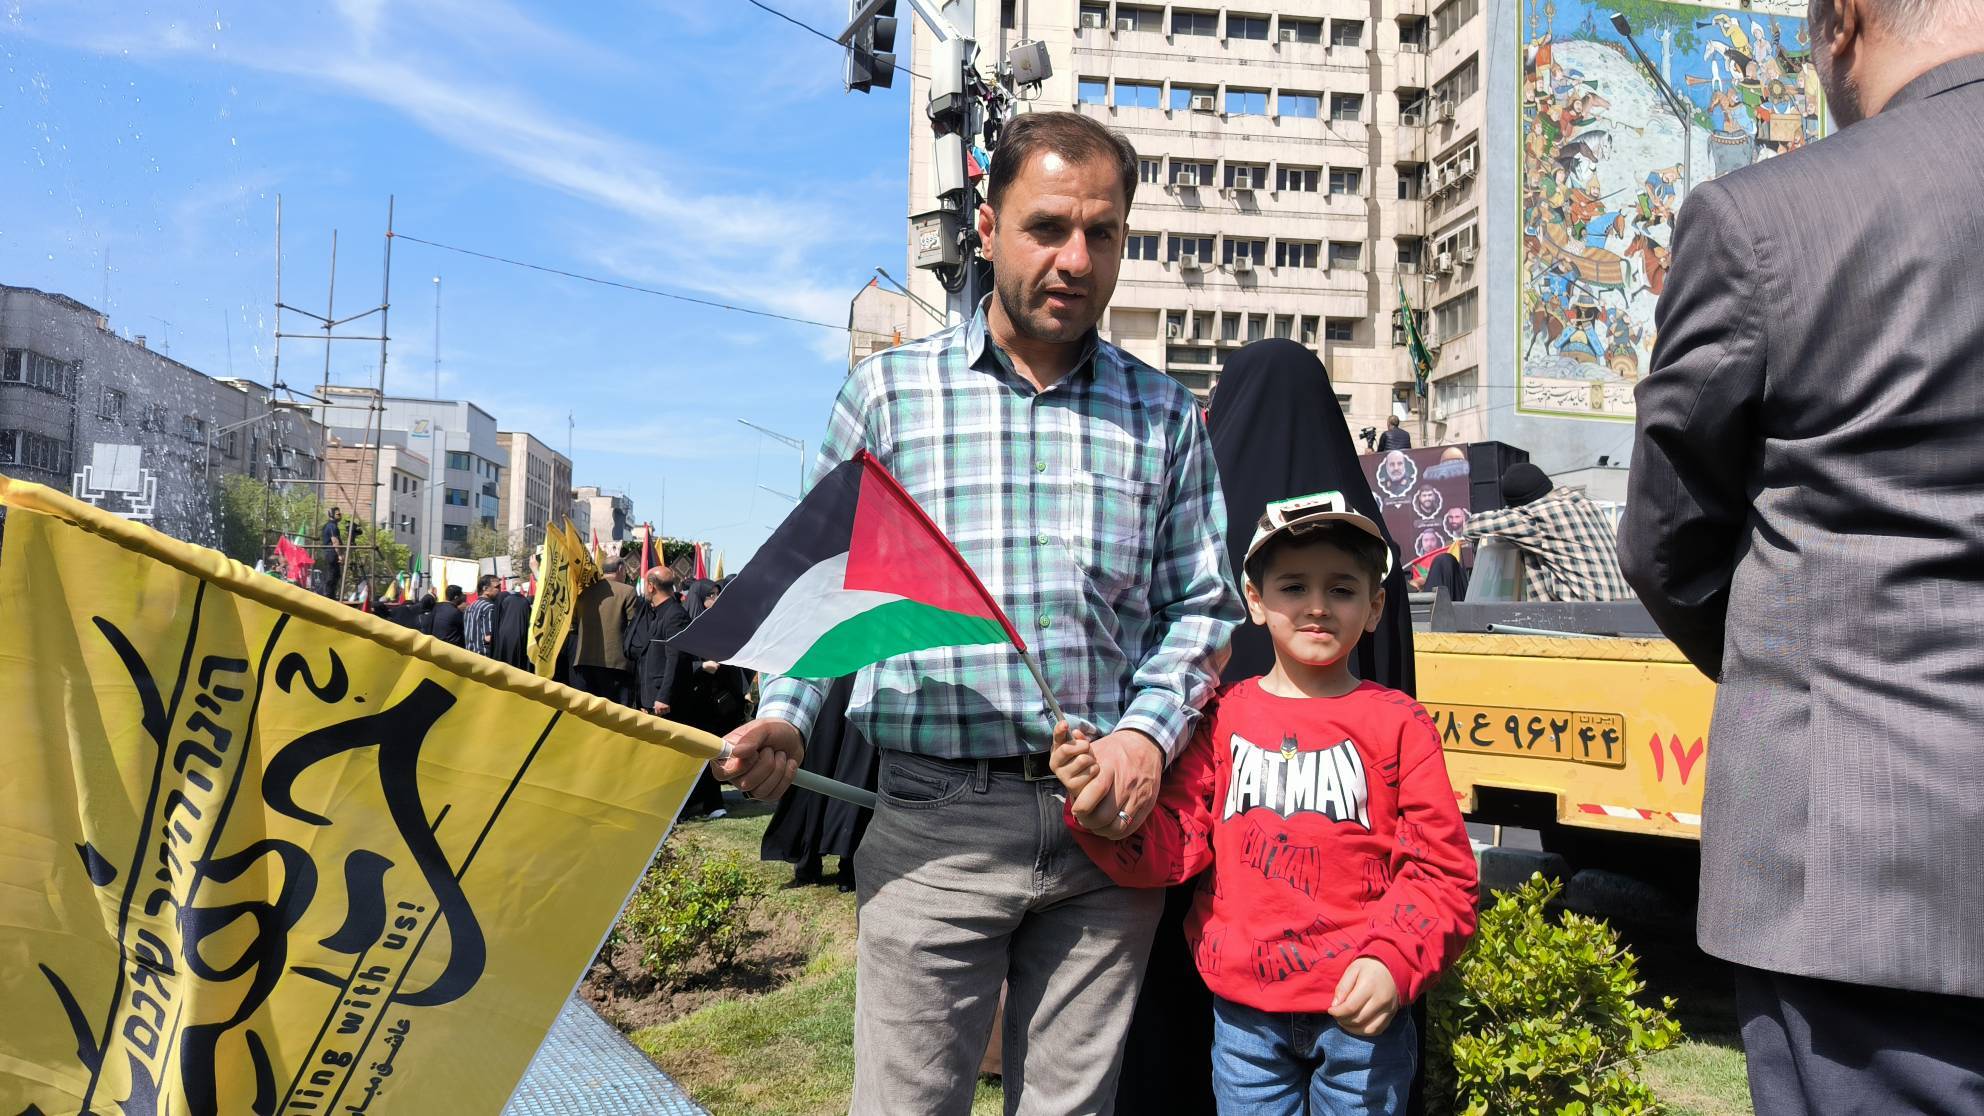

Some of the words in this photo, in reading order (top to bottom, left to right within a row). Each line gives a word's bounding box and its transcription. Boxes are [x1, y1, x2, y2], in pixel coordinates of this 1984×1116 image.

[173, 655, 249, 792] הינה
[121, 928, 177, 1060] שלכם
[336, 965, 391, 1034] with
[382, 901, 426, 950] us!
[369, 1018, 411, 1077] عاشق
